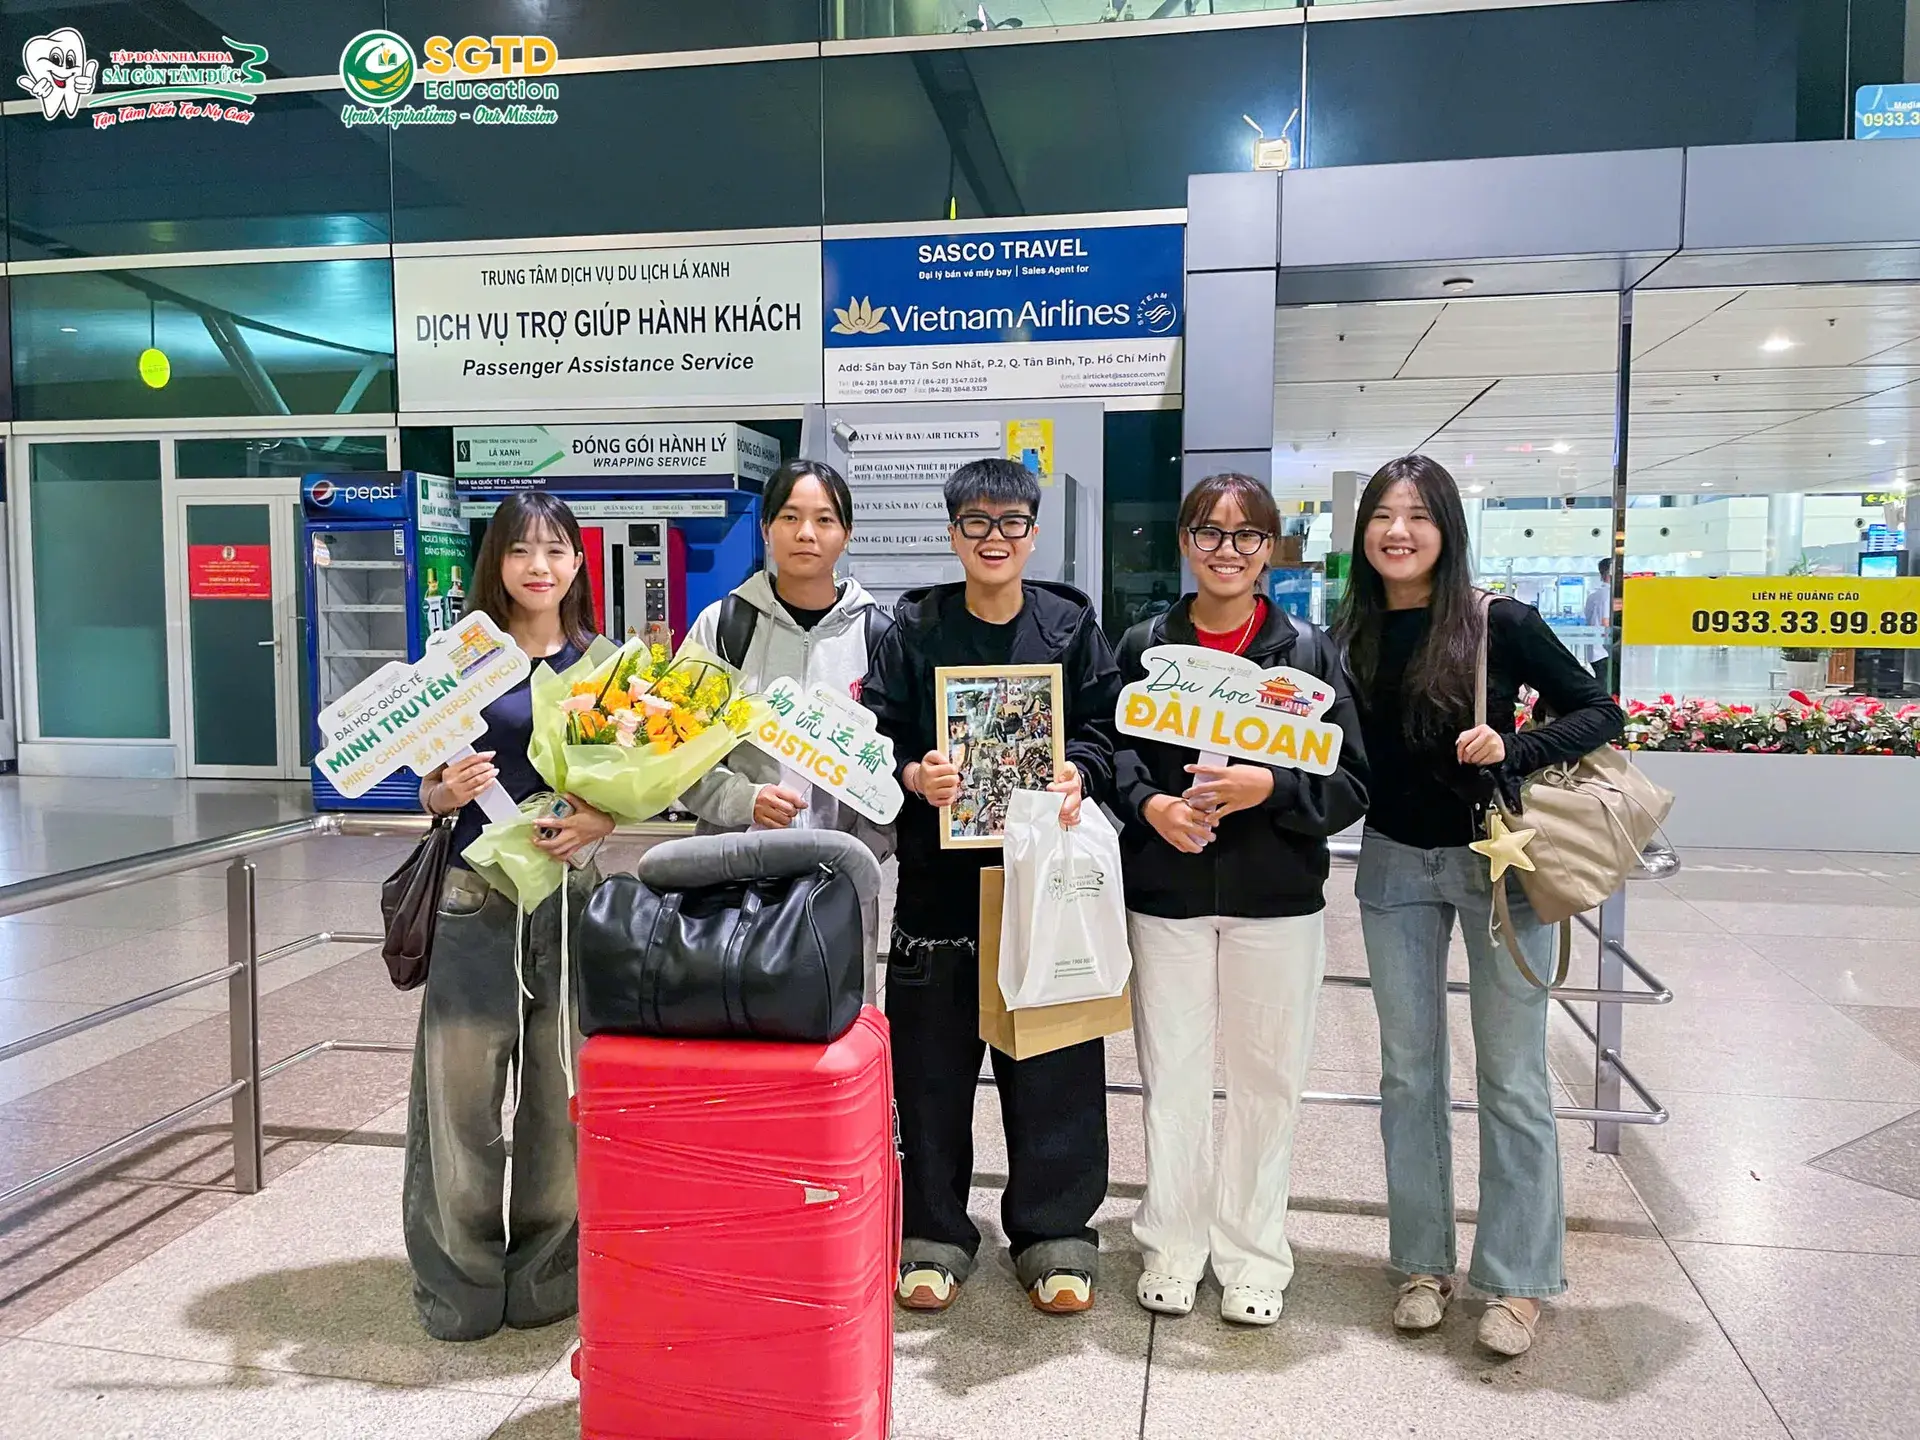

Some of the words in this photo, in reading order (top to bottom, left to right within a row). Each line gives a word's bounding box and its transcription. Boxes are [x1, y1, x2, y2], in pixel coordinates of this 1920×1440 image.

[918, 242, 995, 263] SASCO
[1001, 238, 1088, 259] TRAVEL
[481, 269, 525, 286] TRUNG
[529, 265, 557, 284] TÂM
[561, 267, 592, 286] DỊCH
[596, 266, 615, 285] VỤ
[618, 265, 637, 281] DU
[641, 263, 669, 284] LỊCH
[673, 259, 689, 279] LÁ
[693, 261, 730, 278] XANH
[976, 268, 994, 279] máy
[996, 267, 1013, 278] bay
[1022, 266, 1046, 276] Sales
[1048, 265, 1075, 276] Agent
[1077, 264, 1089, 274] for
[416, 314, 470, 348] DỊCH
[478, 312, 508, 346] VỤ
[516, 311, 567, 345] TRỢ
[574, 301, 630, 337] GIÚP
[639, 300, 706, 335] HÀNH
[715, 297, 801, 333] KHÁCH
[890, 305, 1013, 332] Vietnam
[1016, 299, 1130, 328] Airlines
[463, 359, 564, 379] Passenger
[568, 355, 674, 374] Assistance
[681, 353, 754, 371] Service
[838, 363, 863, 373] Add:
[888, 361, 907, 373] bay
[910, 361, 929, 370] Tân
[932, 361, 952, 370] Sơn
[1009, 358, 1021, 368] Q.
[1023, 357, 1043, 367] Tân
[1078, 355, 1094, 367] Tp.
[1116, 353, 1135, 363] Chí
[1138, 353, 1166, 363] Minh
[572, 435, 620, 454] ĐÓNG
[625, 434, 654, 453] GÓI
[659, 433, 706, 453] HÀNH
[712, 433, 727, 452] LÝ
[943, 431, 980, 439] TICKETS
[499, 449, 521, 457] XANH
[593, 457, 654, 468] WRAPPING
[657, 456, 707, 467] SERVICE
[345, 483, 396, 502] pepsi
[926, 501, 944, 509] CAR
[1752, 590, 1776, 601] LIÊN
[1779, 590, 1793, 601] HỆ
[1797, 589, 1834, 601] QUẢNG
[1837, 590, 1860, 601] CÁO
[1692, 610, 1919, 635] 0933.33.99.88
[1147, 657, 1204, 694] Du
[1209, 676, 1256, 704] học
[334, 724, 355, 742] ĐẠI
[354, 707, 378, 728] HỌC
[379, 683, 411, 711] QUỐC
[409, 670, 424, 688] TẾ
[325, 728, 382, 774] MINH
[377, 673, 458, 734] TRUYỀN
[340, 761, 375, 791] MING
[375, 731, 419, 766] CHUAN
[418, 683, 484, 734] UNIVERSITY
[484, 656, 523, 688] (MCU)
[1124, 691, 1201, 739] ĐÀI
[1210, 710, 1333, 766] LOAN
